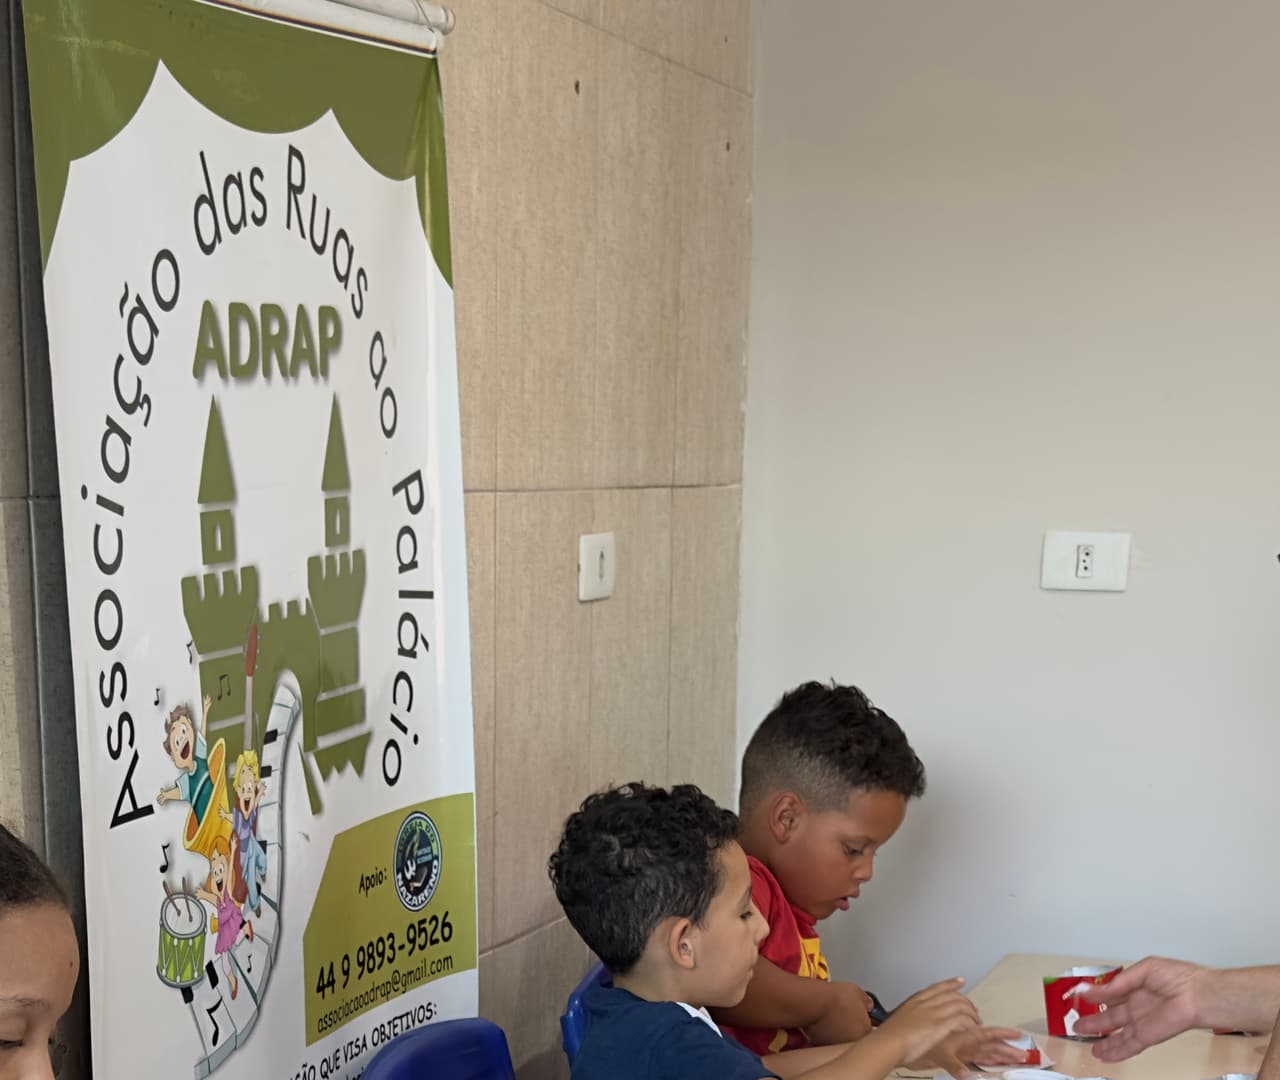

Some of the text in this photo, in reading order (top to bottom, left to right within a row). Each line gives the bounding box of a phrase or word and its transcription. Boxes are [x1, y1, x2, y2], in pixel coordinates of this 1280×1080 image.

[192, 299, 343, 381] ADRAP
[81, 144, 435, 830] Associação das Ruas ao Palácio
[358, 867, 388, 898] Apoio:
[396, 859, 440, 906] NAZARENO
[316, 910, 454, 1000] 44 9 9893-9526
[317, 953, 454, 1034] associacaoadrap@gmail.com
[320, 1048, 341, 1080] QUE
[343, 1033, 369, 1064] VISA
[372, 1001, 439, 1047] OBJETIVOS:
